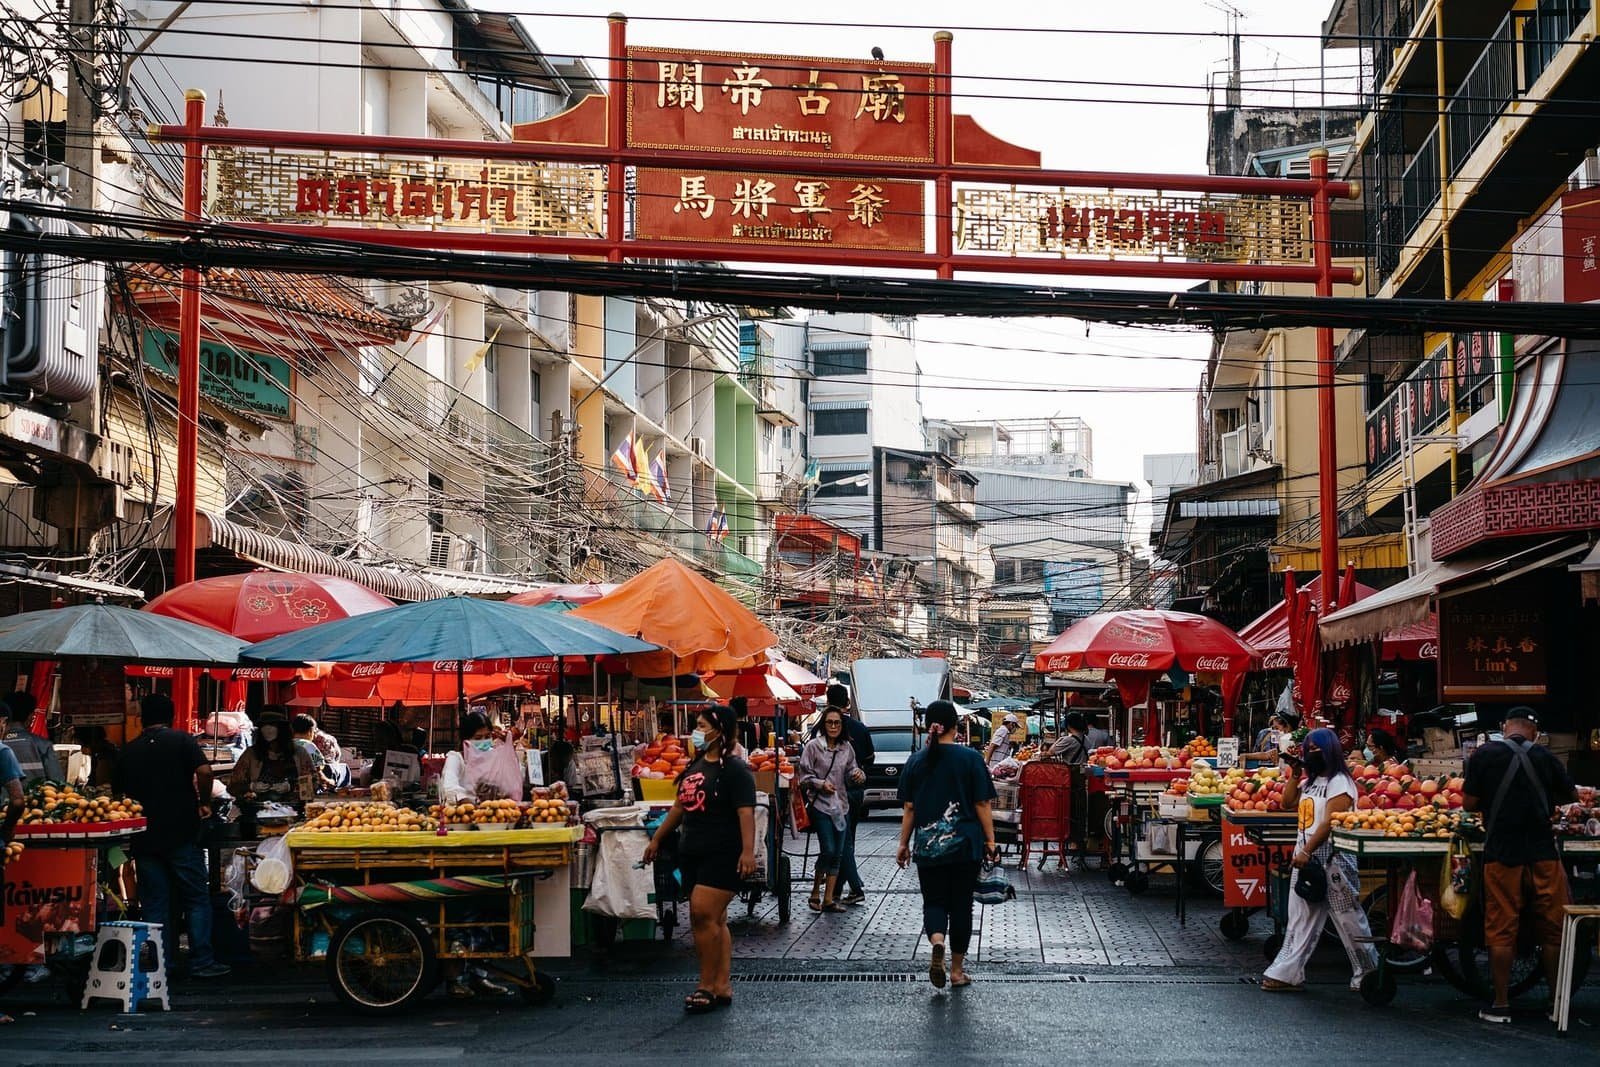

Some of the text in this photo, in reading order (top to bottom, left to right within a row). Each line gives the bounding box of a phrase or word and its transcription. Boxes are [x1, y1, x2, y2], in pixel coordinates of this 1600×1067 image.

[656, 59, 906, 123] 關帝古廟
[296, 168, 517, 221] ตลาดเก่า
[673, 175, 890, 228] 馬將軍爺
[164, 340, 272, 387] ตาดเก่า
[1475, 658, 1518, 673] Lim's
